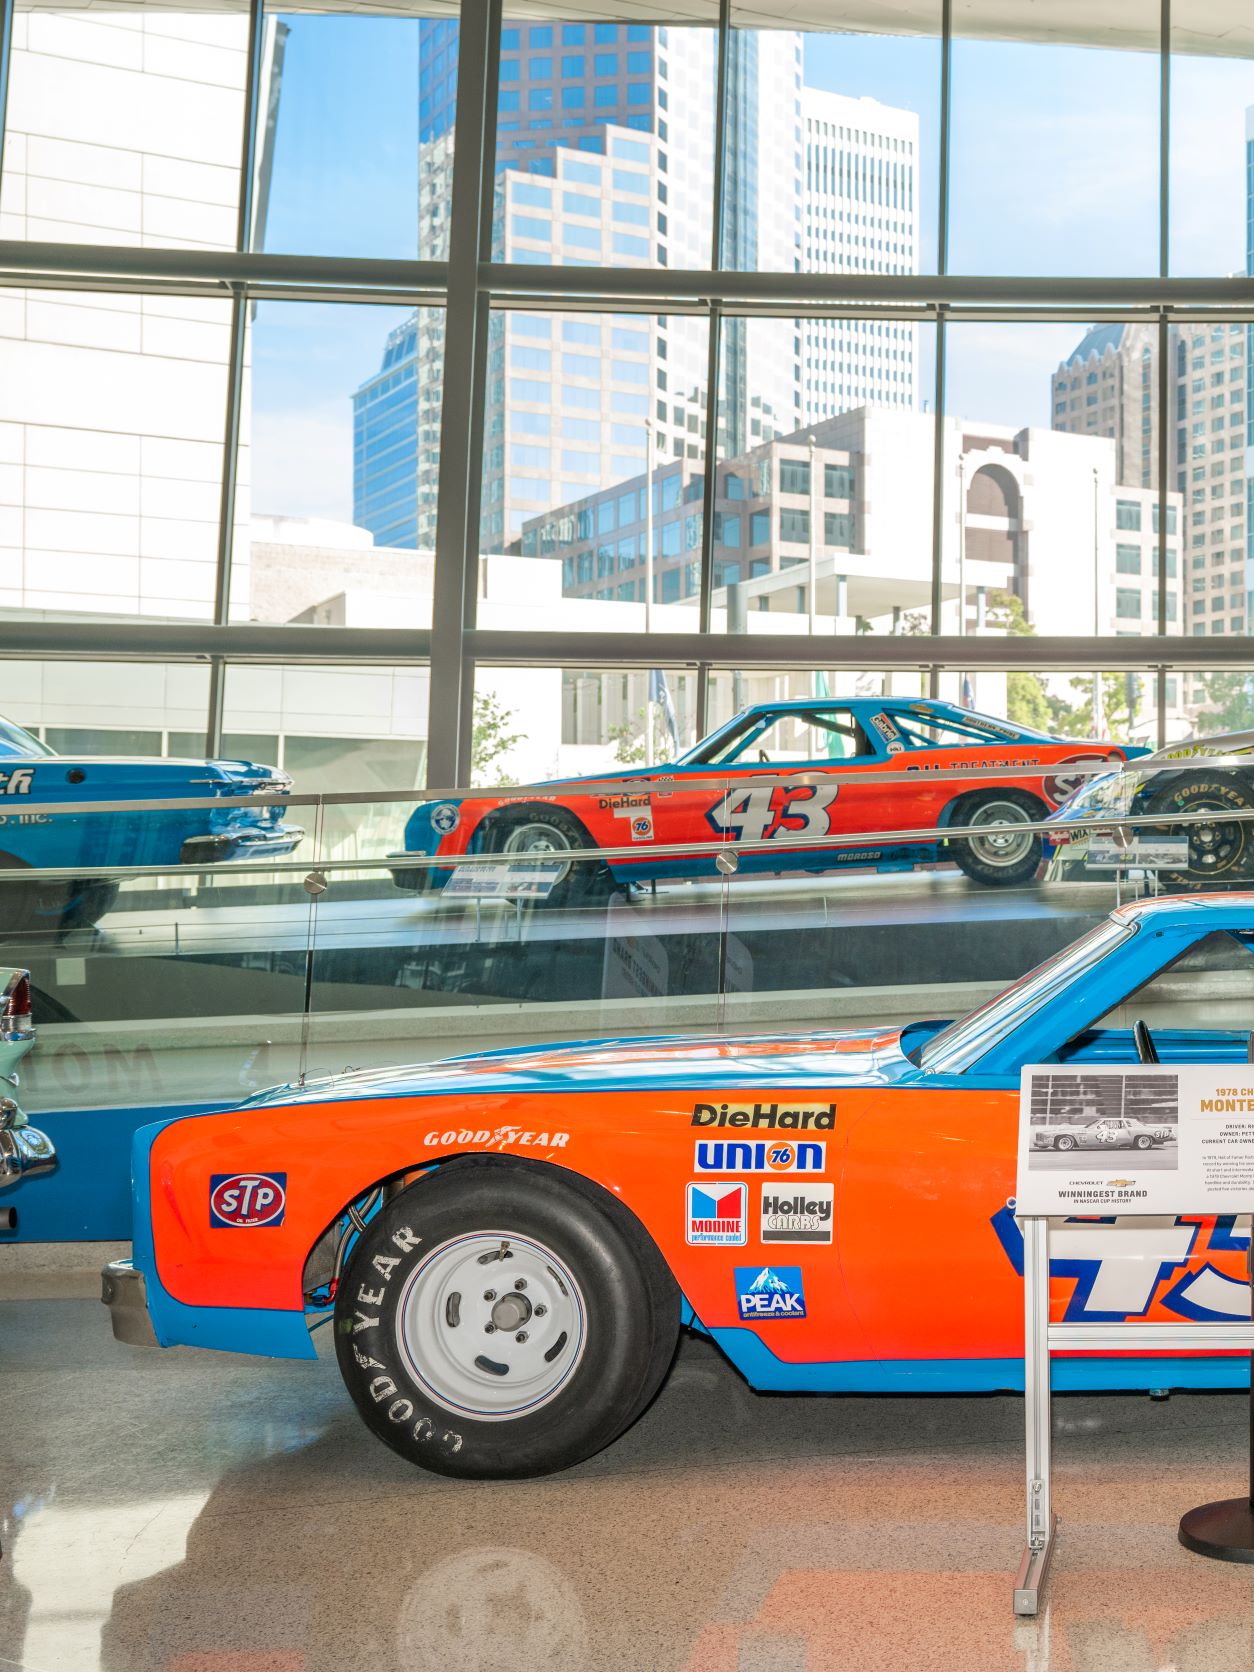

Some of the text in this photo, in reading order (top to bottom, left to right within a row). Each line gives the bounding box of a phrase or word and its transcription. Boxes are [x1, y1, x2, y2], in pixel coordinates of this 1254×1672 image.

[598, 796, 651, 810] DieHard
[704, 772, 839, 841] 43
[635, 820, 649, 832] 76
[1215, 1088, 1239, 1097] 1978
[690, 1103, 837, 1130] DieHard
[221, 1180, 275, 1215] STP
[1058, 1190, 1115, 1198] WINNINGEST
[762, 1195, 833, 1221] Holley
[691, 1220, 742, 1233] MODINE
[767, 1214, 821, 1231] CARBS
[740, 1293, 804, 1313] PEAK
